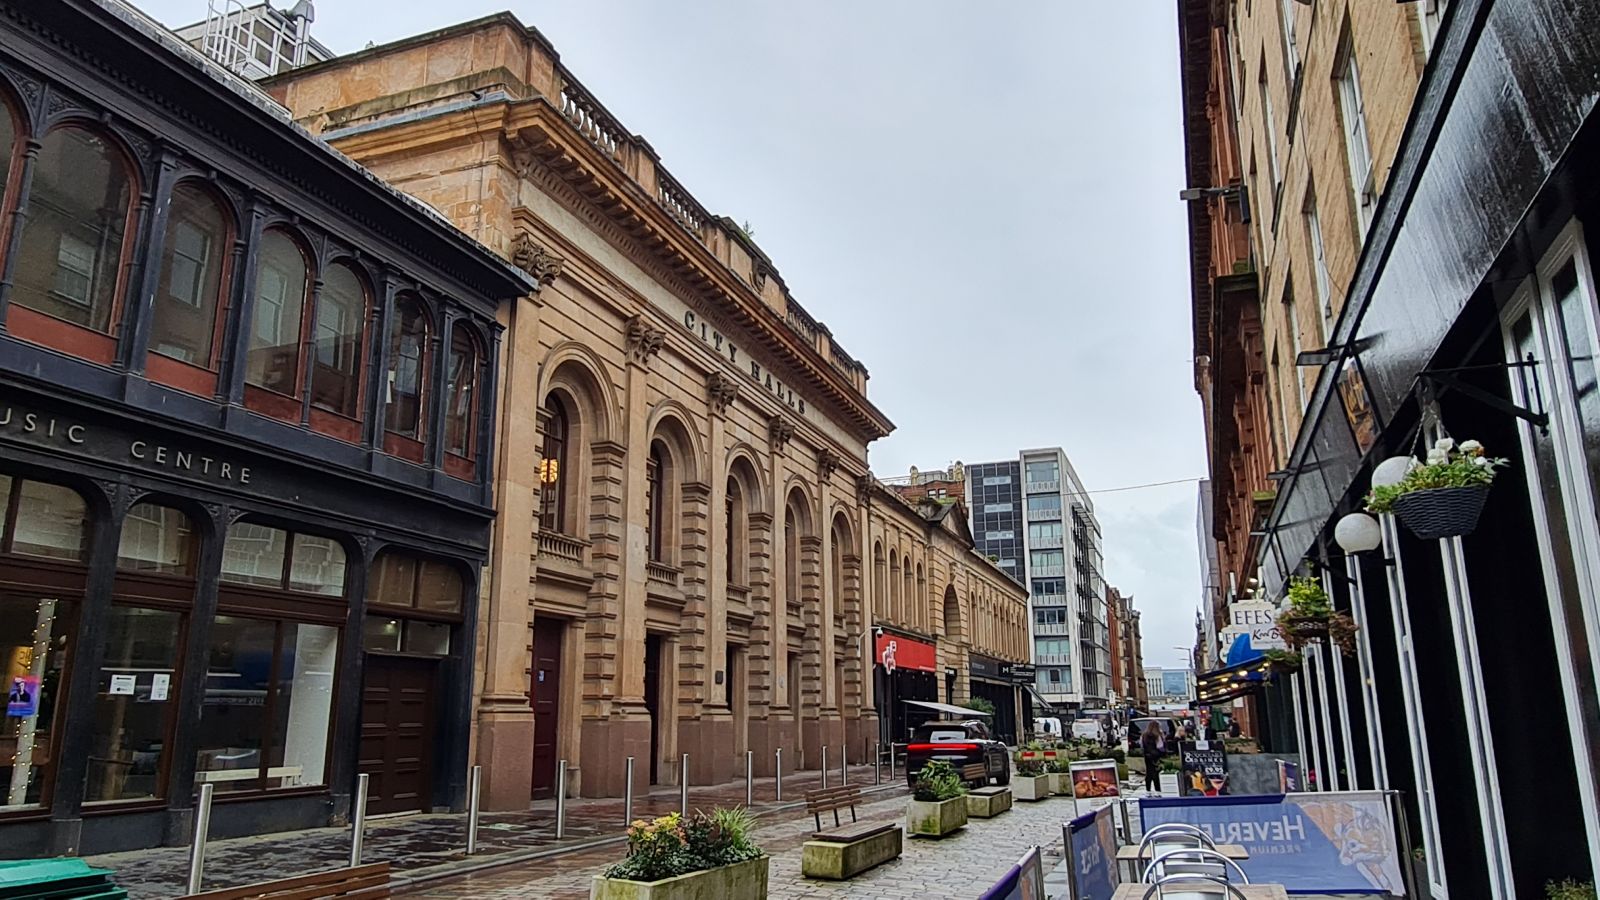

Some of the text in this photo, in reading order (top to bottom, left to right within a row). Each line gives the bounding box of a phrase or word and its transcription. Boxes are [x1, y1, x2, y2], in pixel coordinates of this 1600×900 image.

[684, 310, 805, 415] CITY HALLS
[131, 441, 251, 484] CENTRE
[1234, 609, 1272, 625] EFES
